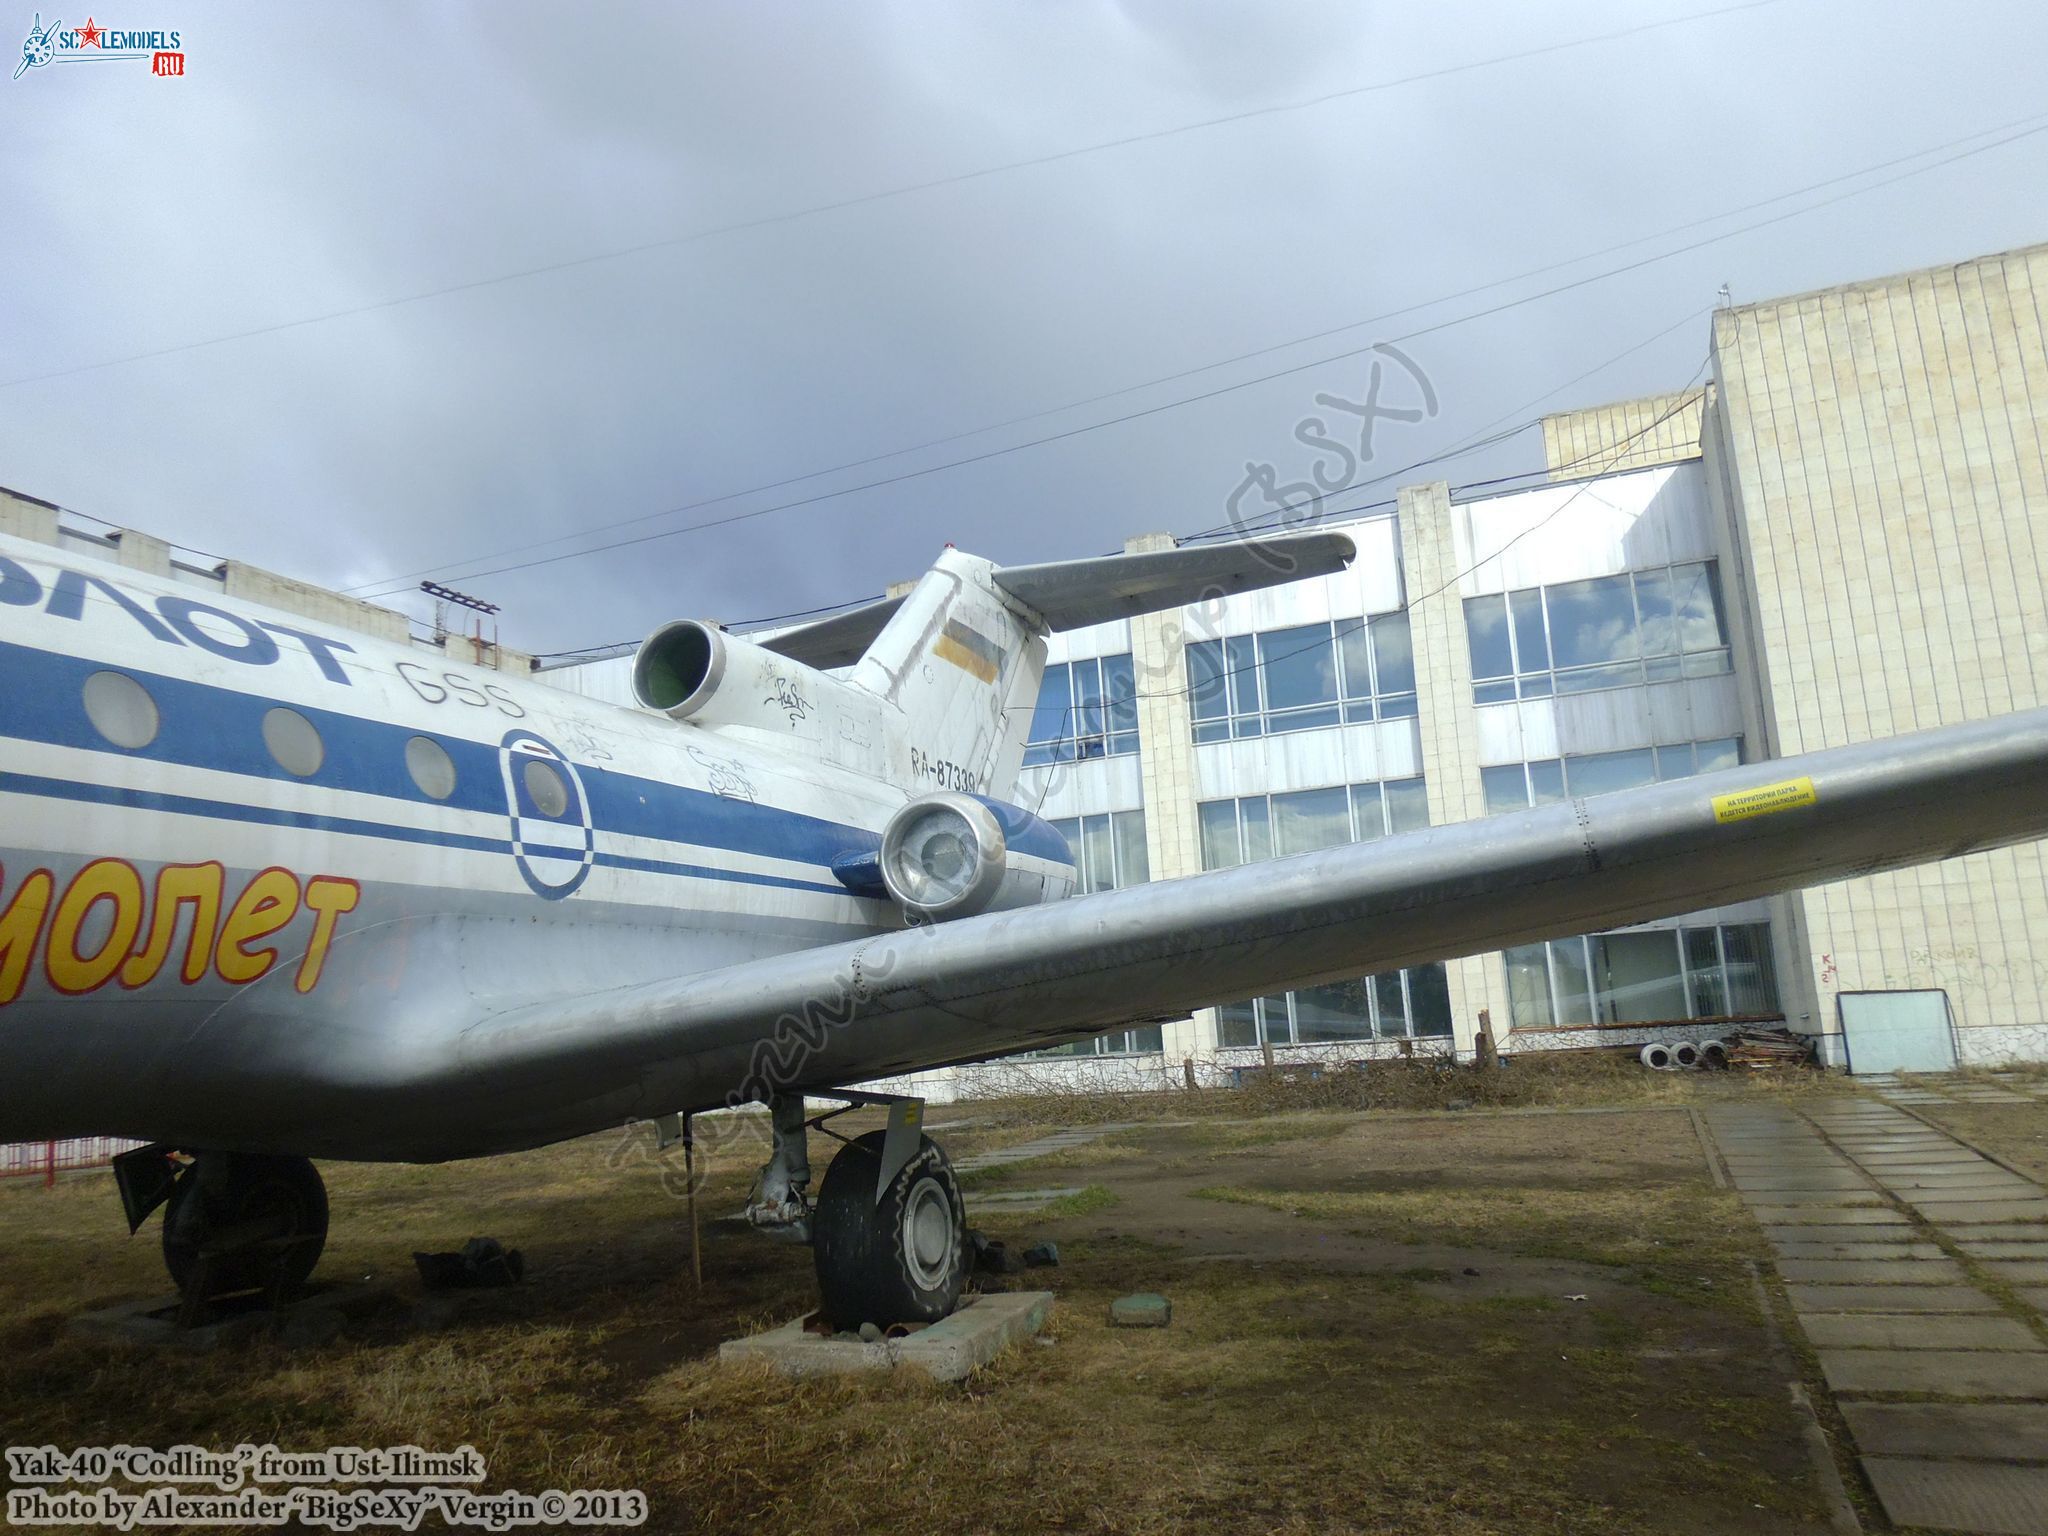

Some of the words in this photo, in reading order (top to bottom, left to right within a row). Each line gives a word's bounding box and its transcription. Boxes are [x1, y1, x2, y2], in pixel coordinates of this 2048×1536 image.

[911, 747, 976, 793] RA-87339
[1736, 791, 1777, 805] ТЕРРИТОРИИ
[1777, 786, 1798, 797] ПАРКА
